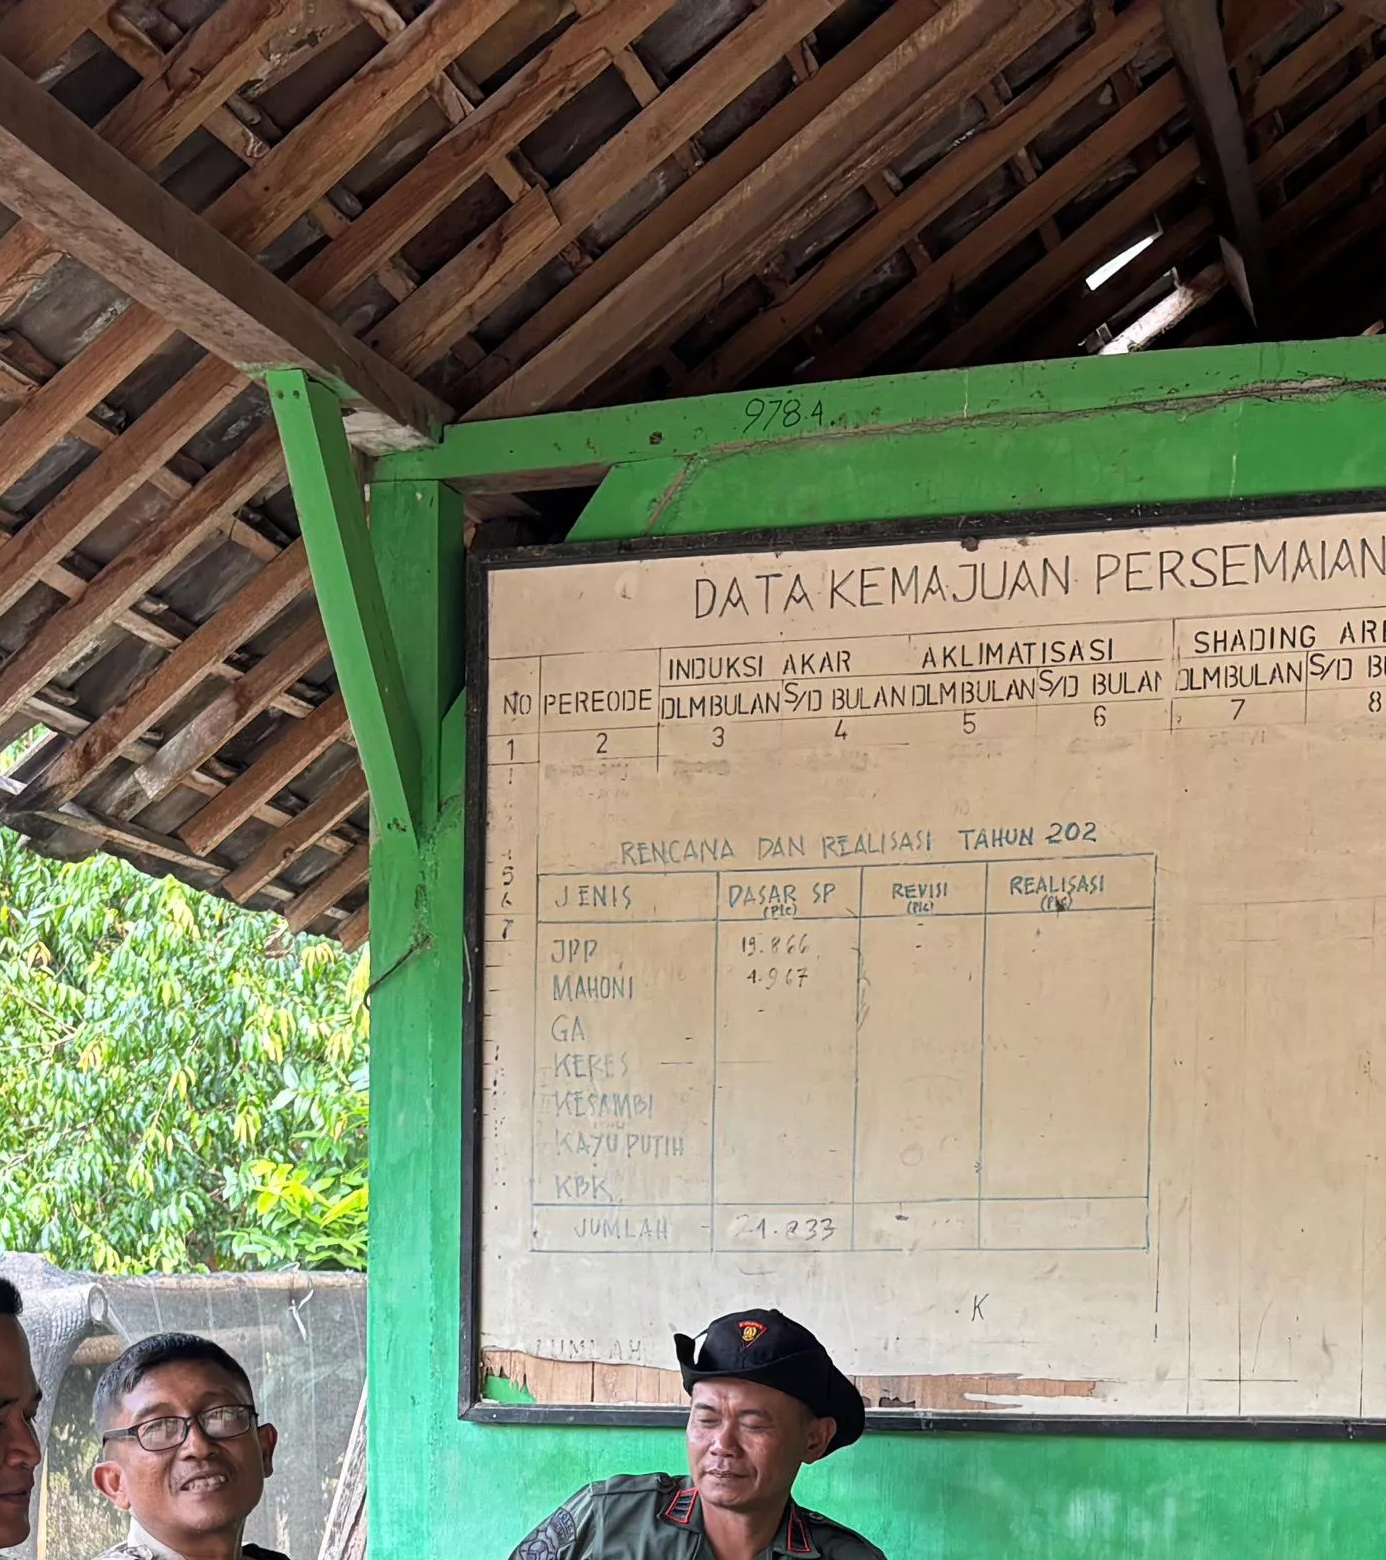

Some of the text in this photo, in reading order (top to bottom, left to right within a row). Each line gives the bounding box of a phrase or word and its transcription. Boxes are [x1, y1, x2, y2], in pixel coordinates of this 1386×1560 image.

[694, 572, 814, 619] DATA
[829, 556, 1071, 609] KEMAJUAN
[1097, 534, 1386, 593] PERSEMAIAN
[1194, 625, 1316, 654] SHADING
[669, 650, 851, 680] INDUKSI AKAR
[922, 638, 1113, 669] AKLIMATISASI
[503, 693, 532, 716] NO
[544, 689, 652, 716] PEREODE
[832, 684, 906, 710] BULAN
[1231, 699, 1245, 720] 7
[1368, 691, 1382, 712] 8
[963, 712, 976, 734] 5
[1094, 705, 1107, 727] 6
[712, 726, 725, 748] 3
[834, 719, 848, 740] 4
[507, 739, 514, 760] 1
[596, 733, 608, 754] 2
[621, 821, 1096, 866] RENCANA DAN REALISASI TAHUN 202
[555, 885, 632, 910] JENIS
[728, 882, 836, 908] DASAR SP
[892, 882, 948, 900] REVISI
[1010, 874, 1105, 897] REALISASI
[551, 938, 598, 964] JPP
[553, 974, 634, 1001] MAHONI
[551, 1014, 586, 1042] GA
[574, 1217, 669, 1241] JUMLAH
[971, 1293, 989, 1322] K
